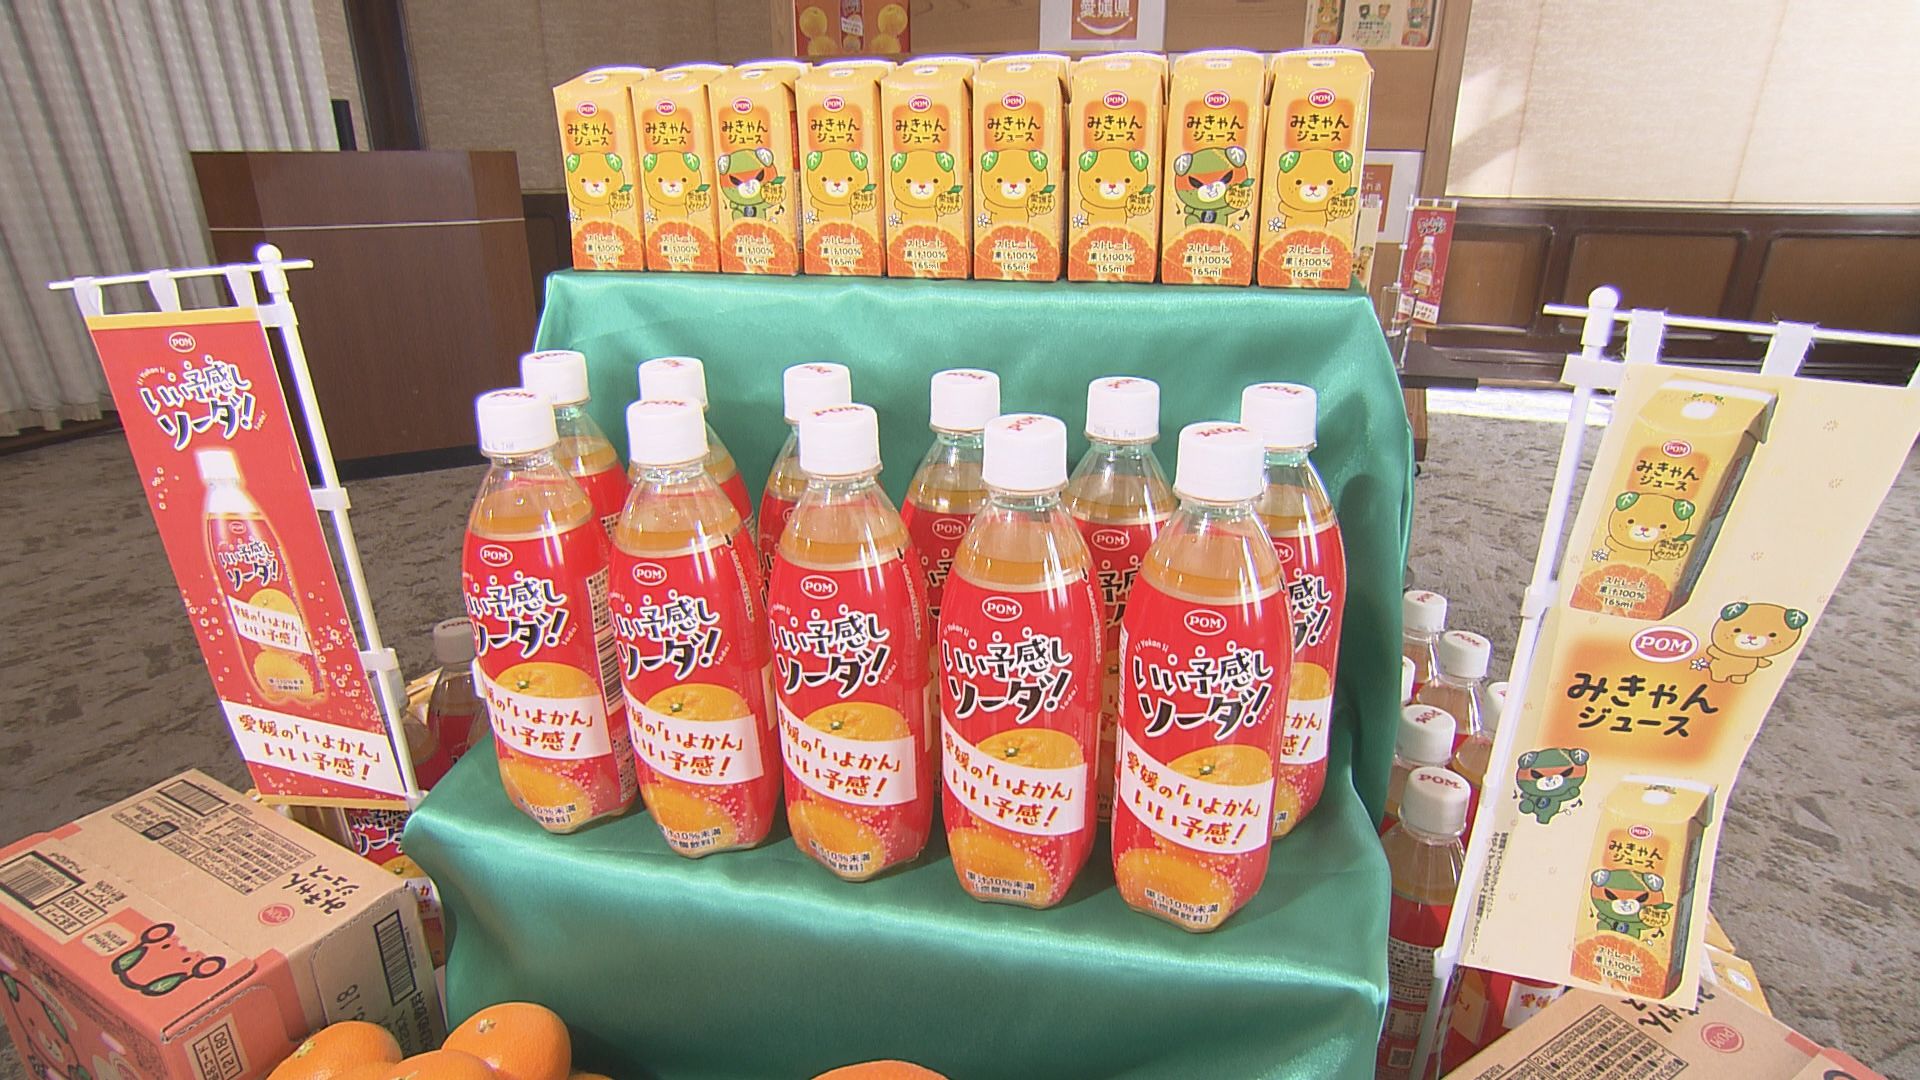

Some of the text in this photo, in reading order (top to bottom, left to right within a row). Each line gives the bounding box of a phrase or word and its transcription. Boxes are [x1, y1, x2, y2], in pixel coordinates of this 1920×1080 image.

[825, 99, 842, 109] POM
[912, 99, 928, 109] POM
[1005, 96, 1023, 107] POM
[1106, 95, 1124, 104] POM
[1207, 95, 1226, 104] POM
[1312, 93, 1331, 103] POM
[735, 100, 751, 110] POM
[645, 121, 691, 134] みきゃん
[722, 120, 768, 133] みきゃん
[810, 118, 860, 131] みきゃん
[896, 118, 947, 132] みきゃん
[987, 116, 1041, 130] みきゃん
[1087, 115, 1142, 129] みきゃん
[1187, 115, 1244, 130] みきゃん
[1290, 114, 1350, 131] みきゃん
[567, 122, 613, 136] みきゃん
[574, 136, 609, 146] ジュース
[652, 135, 687, 145] ジュース
[729, 133, 763, 144] ジュース
[817, 132, 855, 143] ジュース
[902, 133, 941, 144] ジュース
[994, 131, 1035, 143] ジュース
[1094, 131, 1136, 142] ジュース
[1193, 131, 1237, 142] ジュース
[1297, 131, 1342, 142] ジュース
[1091, 241, 1132, 250] ストレート
[1188, 243, 1230, 253] ストレート
[1288, 246, 1331, 255] ストレート
[1292, 269, 1322, 279] 165ml
[172, 336, 193, 348] POM
[140, 361, 252, 415] いい予感し
[1665, 444, 1690, 455] POM
[1636, 459, 1700, 482] みきゃん
[1640, 475, 1687, 492] ジュース
[936, 524, 962, 534] POM
[1096, 535, 1125, 545] POM
[483, 551, 508, 562] POM
[637, 569, 662, 579] POM
[804, 582, 833, 593] POM
[1605, 576, 1646, 589] ストレート
[1599, 586, 1645, 600] 果汁100%
[987, 604, 1017, 616] POM
[1604, 598, 1633, 609] 165ml
[1190, 616, 1222, 629] POM
[771, 612, 890, 656] いい予感し
[1638, 636, 1691, 653] POM
[943, 634, 1073, 679] いい予感し
[1133, 650, 1273, 699] いい予感し
[949, 670, 1073, 724] ソーダ!
[1567, 672, 1719, 715] みきゃん
[1139, 685, 1272, 741] ソーダ!
[1578, 706, 1690, 737] ジュース
[238, 713, 381, 762] 愛媛の「いよかん」
[264, 743, 370, 781] いい予感!
[945, 732, 1073, 802] 愛媛の「いよかん」
[788, 744, 888, 798] いい予感!
[1127, 751, 1261, 818] 愛媛の「いよかん」
[1418, 773, 1462, 790] POM
[953, 769, 1059, 827] いい予感!
[1134, 789, 1247, 845] いい予感!
[1608, 839, 1664, 861] みきゃん
[1613, 854, 1655, 869] ジュース
[309, 865, 360, 896] ジュース
[282, 873, 347, 914] みきゃん
[60, 893, 98, 921] 121180
[1601, 968, 1631, 982] 165ml
[1709, 1027, 1735, 1049] POM
[213, 1029, 240, 1074] 121180
